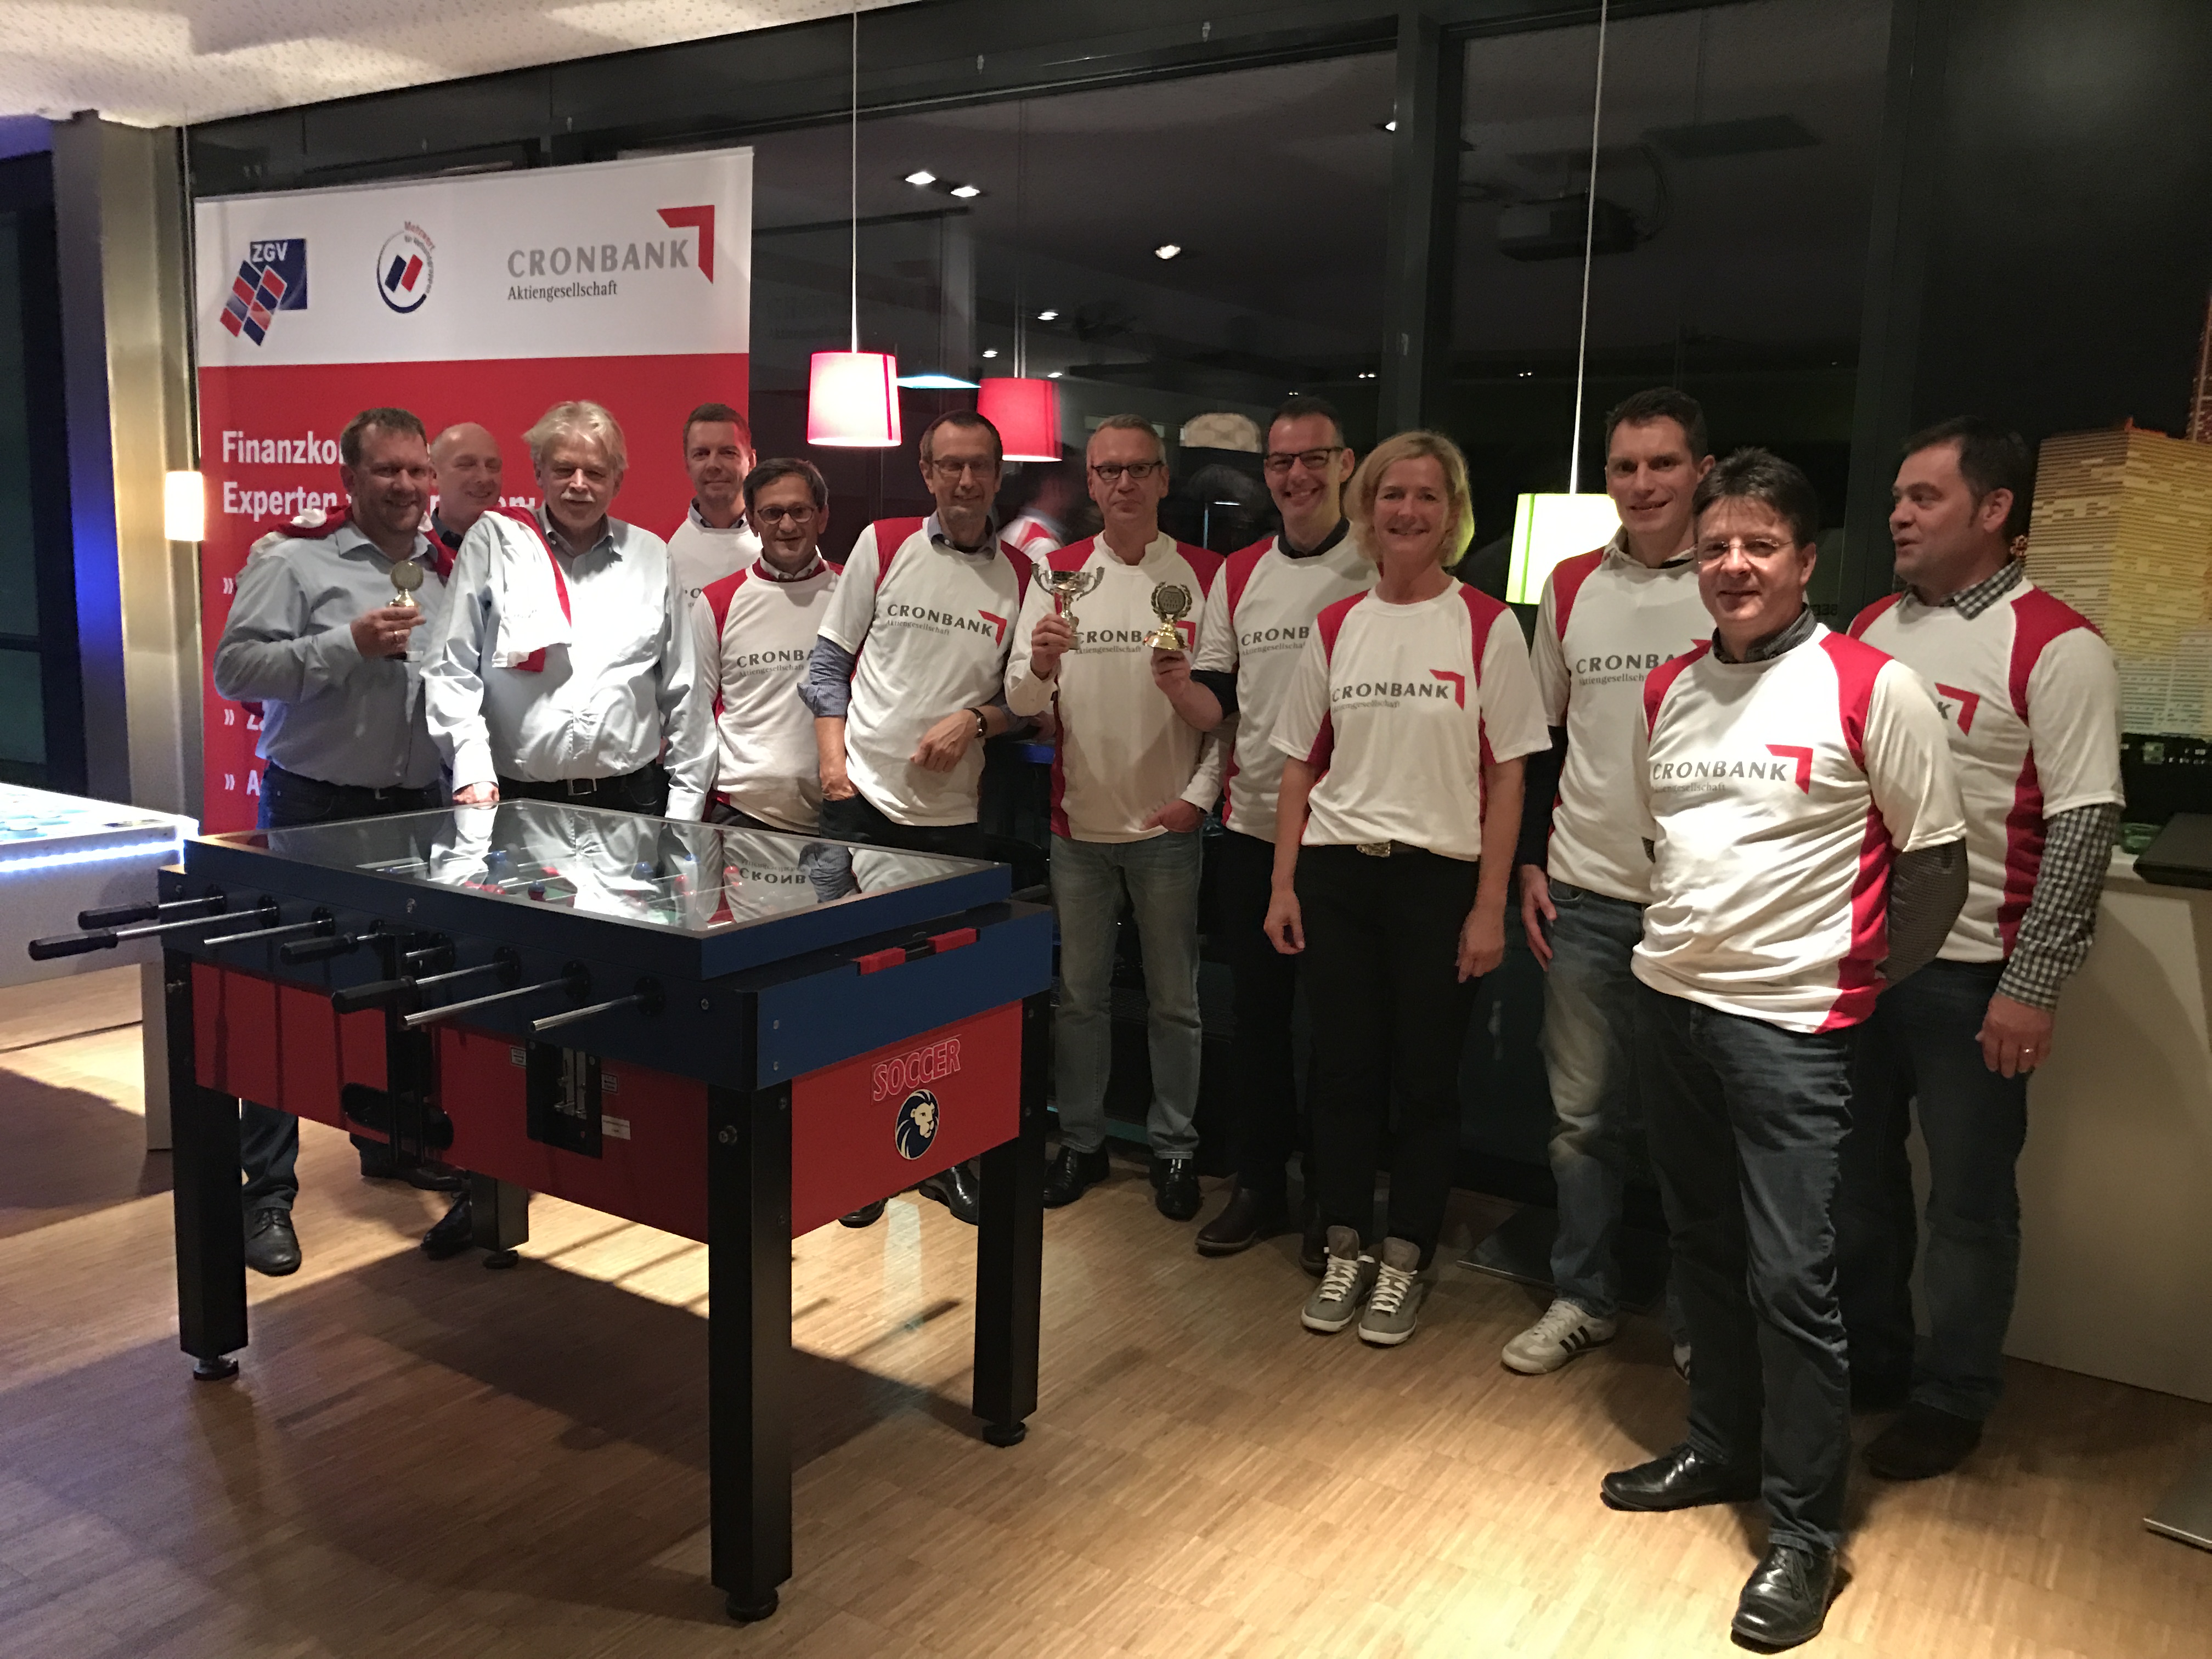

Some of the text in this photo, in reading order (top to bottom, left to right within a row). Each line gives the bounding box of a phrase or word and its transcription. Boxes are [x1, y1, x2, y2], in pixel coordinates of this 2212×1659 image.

[252, 242, 288, 262] ZGV
[507, 240, 689, 278] CRONBANK
[507, 280, 618, 303] Aktiengesellschaft
[223, 431, 344, 464] Finanzko
[223, 481, 337, 522] Experten
[885, 620, 950, 636] Aktiengesellschaft
[887, 604, 992, 637] CRONBANK
[1075, 630, 1152, 644] CRONB
[1242, 627, 1310, 646] CRONB
[737, 650, 814, 668] CRONBA
[1242, 641, 1306, 656] Aktiengesellscha
[1576, 653, 1675, 674] CRONBA
[1579, 673, 1645, 685] Aktiengesellsch
[1332, 682, 1449, 703] CRONBANK
[1652, 761, 1787, 782] CRONBANK
[873, 1039, 961, 1102] SOCCER
